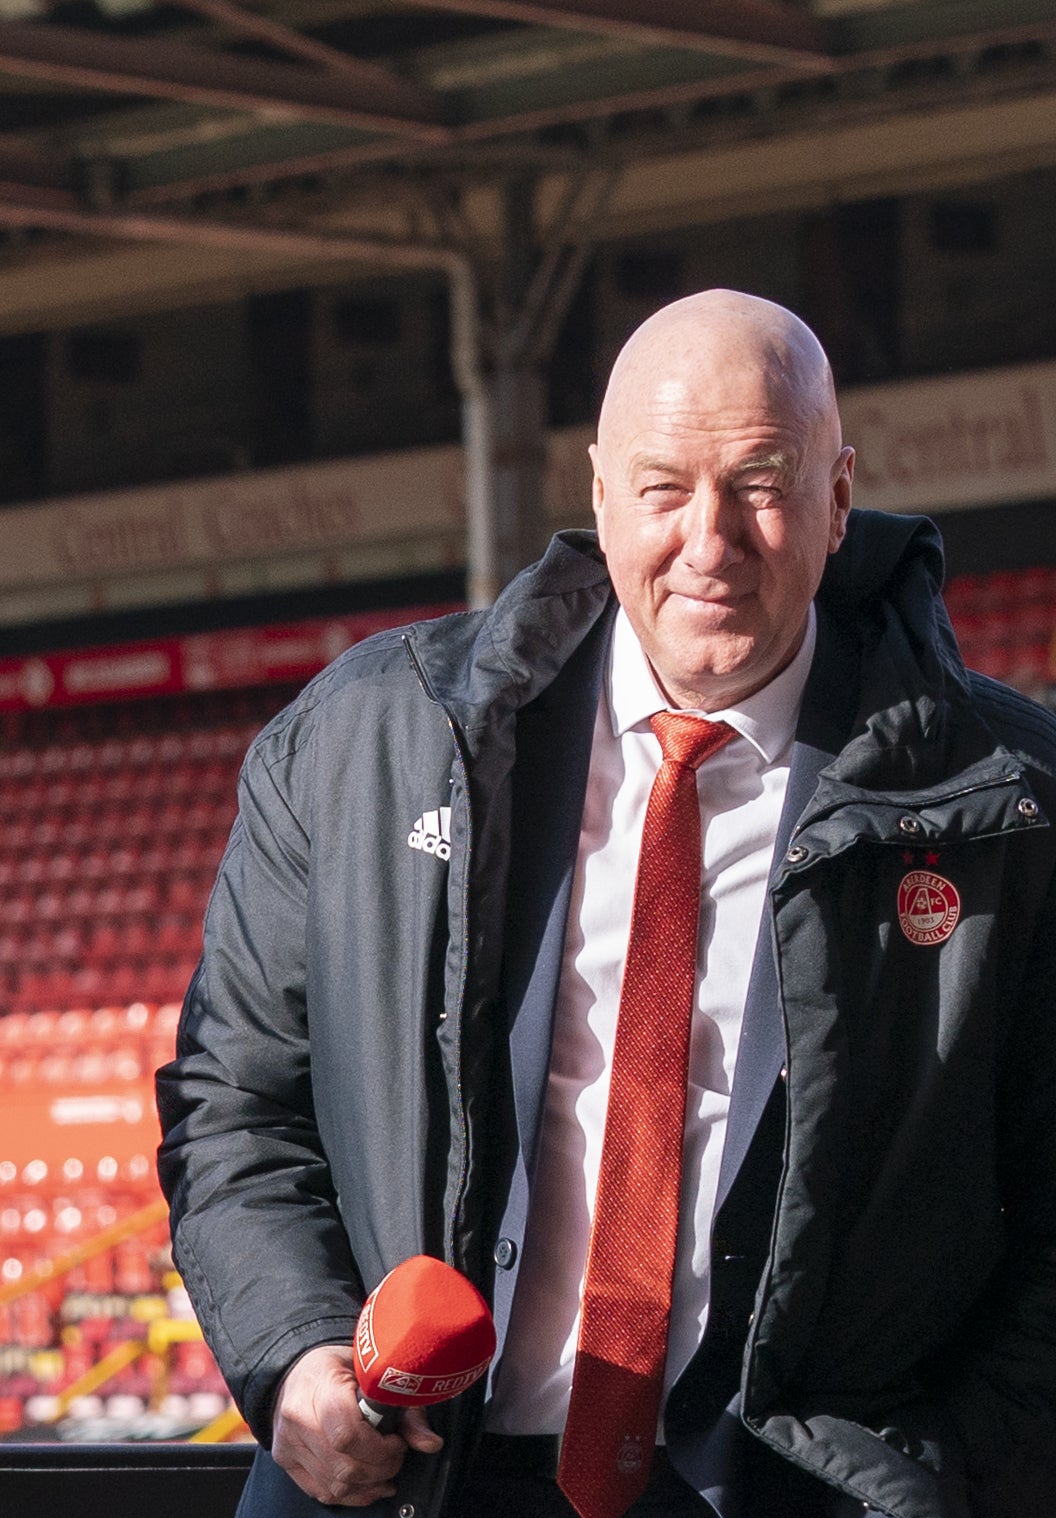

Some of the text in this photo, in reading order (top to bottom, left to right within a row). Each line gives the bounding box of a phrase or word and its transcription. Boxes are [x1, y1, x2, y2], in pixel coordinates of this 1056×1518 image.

[903, 874, 946, 893] ABERDEEN
[900, 912, 943, 942] FOOTBALL
[942, 905, 958, 933] CLUB
